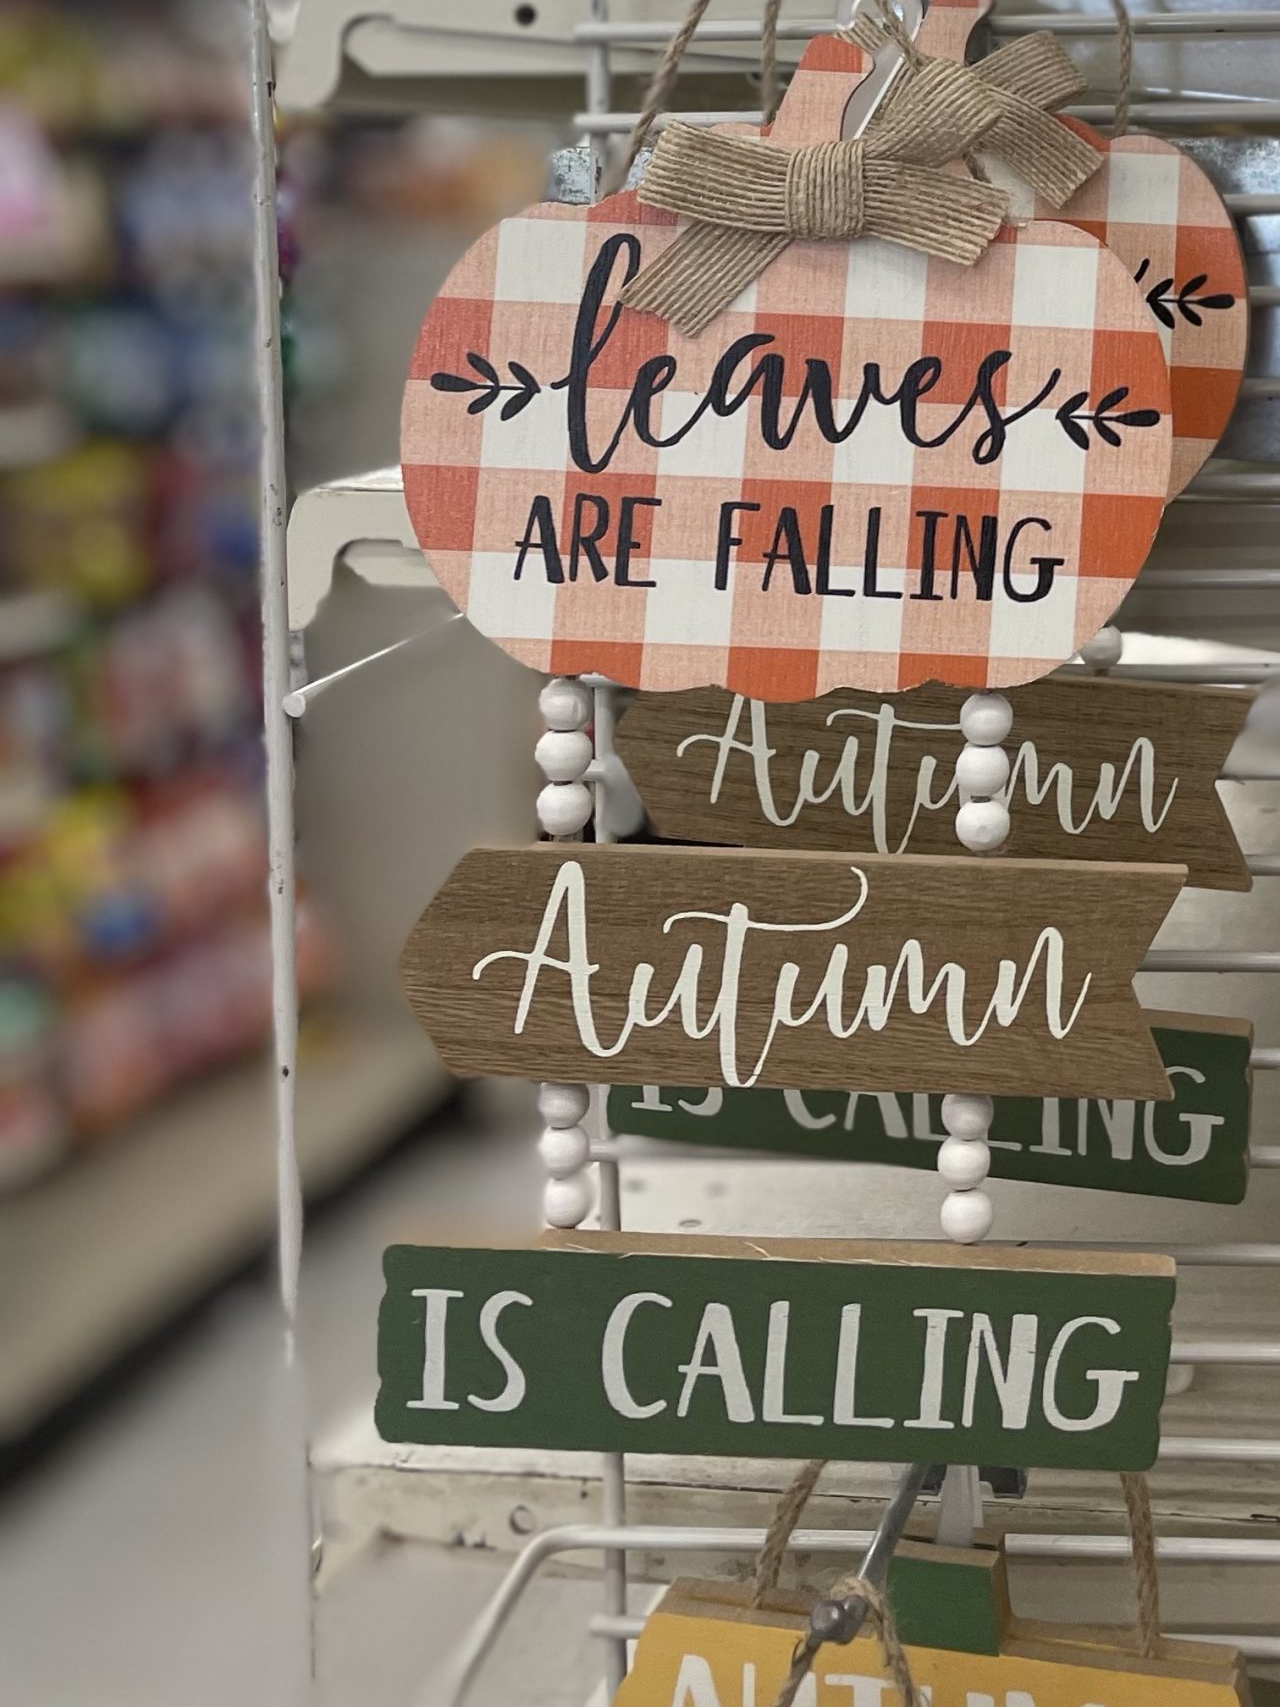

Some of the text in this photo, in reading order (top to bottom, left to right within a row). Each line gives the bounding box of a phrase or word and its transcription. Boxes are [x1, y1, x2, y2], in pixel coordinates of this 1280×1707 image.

[512, 493, 1066, 604] ARE FALLING
[472, 861, 1093, 1088] Autumn
[406, 1288, 1139, 1432] IS CALLING
